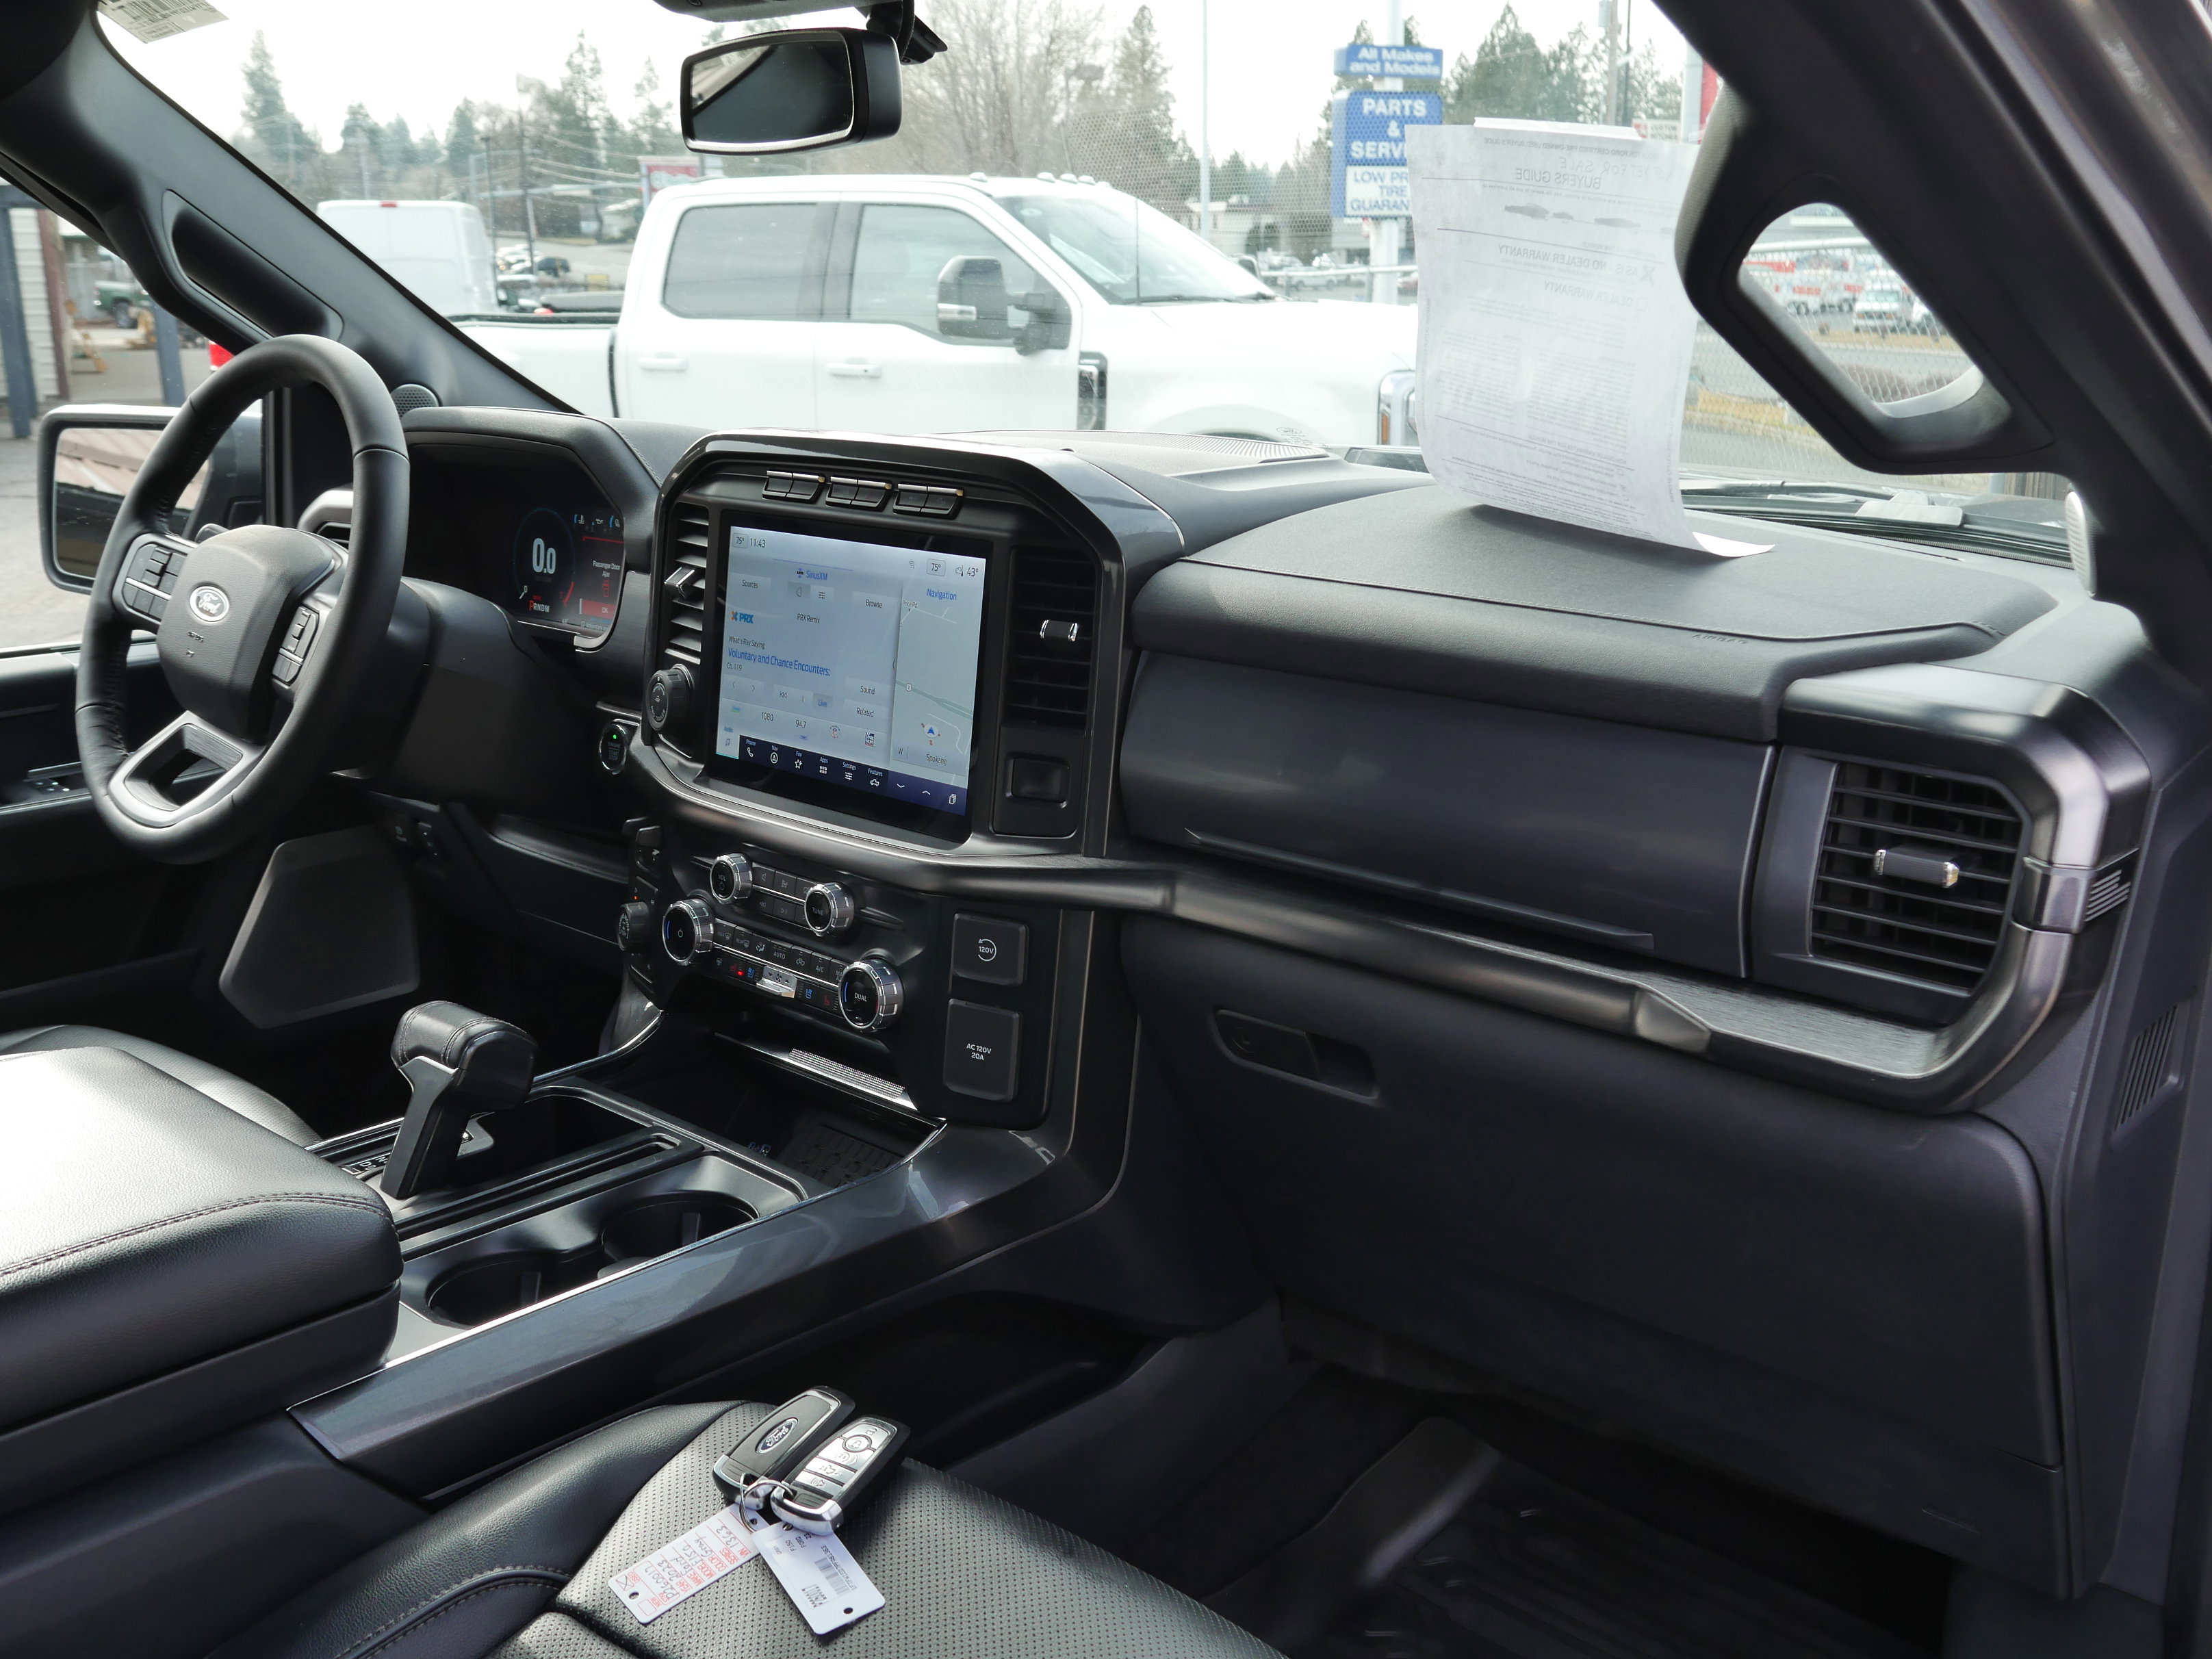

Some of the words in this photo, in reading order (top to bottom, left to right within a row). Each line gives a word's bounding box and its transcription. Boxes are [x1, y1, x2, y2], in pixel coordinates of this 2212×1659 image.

[1358, 47, 1378, 60] All
[1381, 48, 1434, 62] Makes
[1350, 60, 1380, 73] and
[1384, 62, 1440, 77] Models
[1362, 98, 1427, 117] PARTS
[1387, 120, 1401, 137] &
[1354, 171, 1385, 183] LOW
[1390, 172, 1409, 183] PR
[1378, 185, 1407, 198] TIRE
[1350, 199, 1411, 212] GUARAN
[749, 538, 766, 548] 11:43
[806, 570, 827, 580] SiriusXM
[742, 580, 758, 589] Sources
[927, 588, 957, 601] Navigation
[866, 599, 882, 608] Browse
[797, 613, 806, 621] PRX
[808, 615, 820, 623] Remix
[729, 636, 743, 645] What's
[751, 640, 765, 650] Saying
[728, 647, 757, 663] Voluntary
[758, 654, 769, 664] and
[771, 656, 793, 669] Chance
[794, 660, 830, 676] Encounters:
[860, 685, 875, 695] Sound
[761, 712, 773, 721] 1080
[856, 707, 874, 717] Related
[795, 719, 806, 729] 94.7
[926, 754, 947, 765] Spokane
[843, 761, 856, 771] Settings
[868, 768, 883, 777] Features
[812, 907, 825, 916] TUNE
[773, 951, 786, 960] AUTO
[979, 946, 994, 955] 120V
[816, 965, 824, 973] A/C
[854, 992, 868, 1002] DUAL
[976, 1045, 992, 1054] 120V
[971, 1052, 984, 1061] 20A
[719, 1547, 738, 1565] SERIES
[708, 1556, 725, 1572] COLOR
[657, 1559, 680, 1582] 2023
[697, 1562, 714, 1579] MODEL
[686, 1571, 703, 1586] MAKE
[676, 1580, 689, 1593] YEAR
